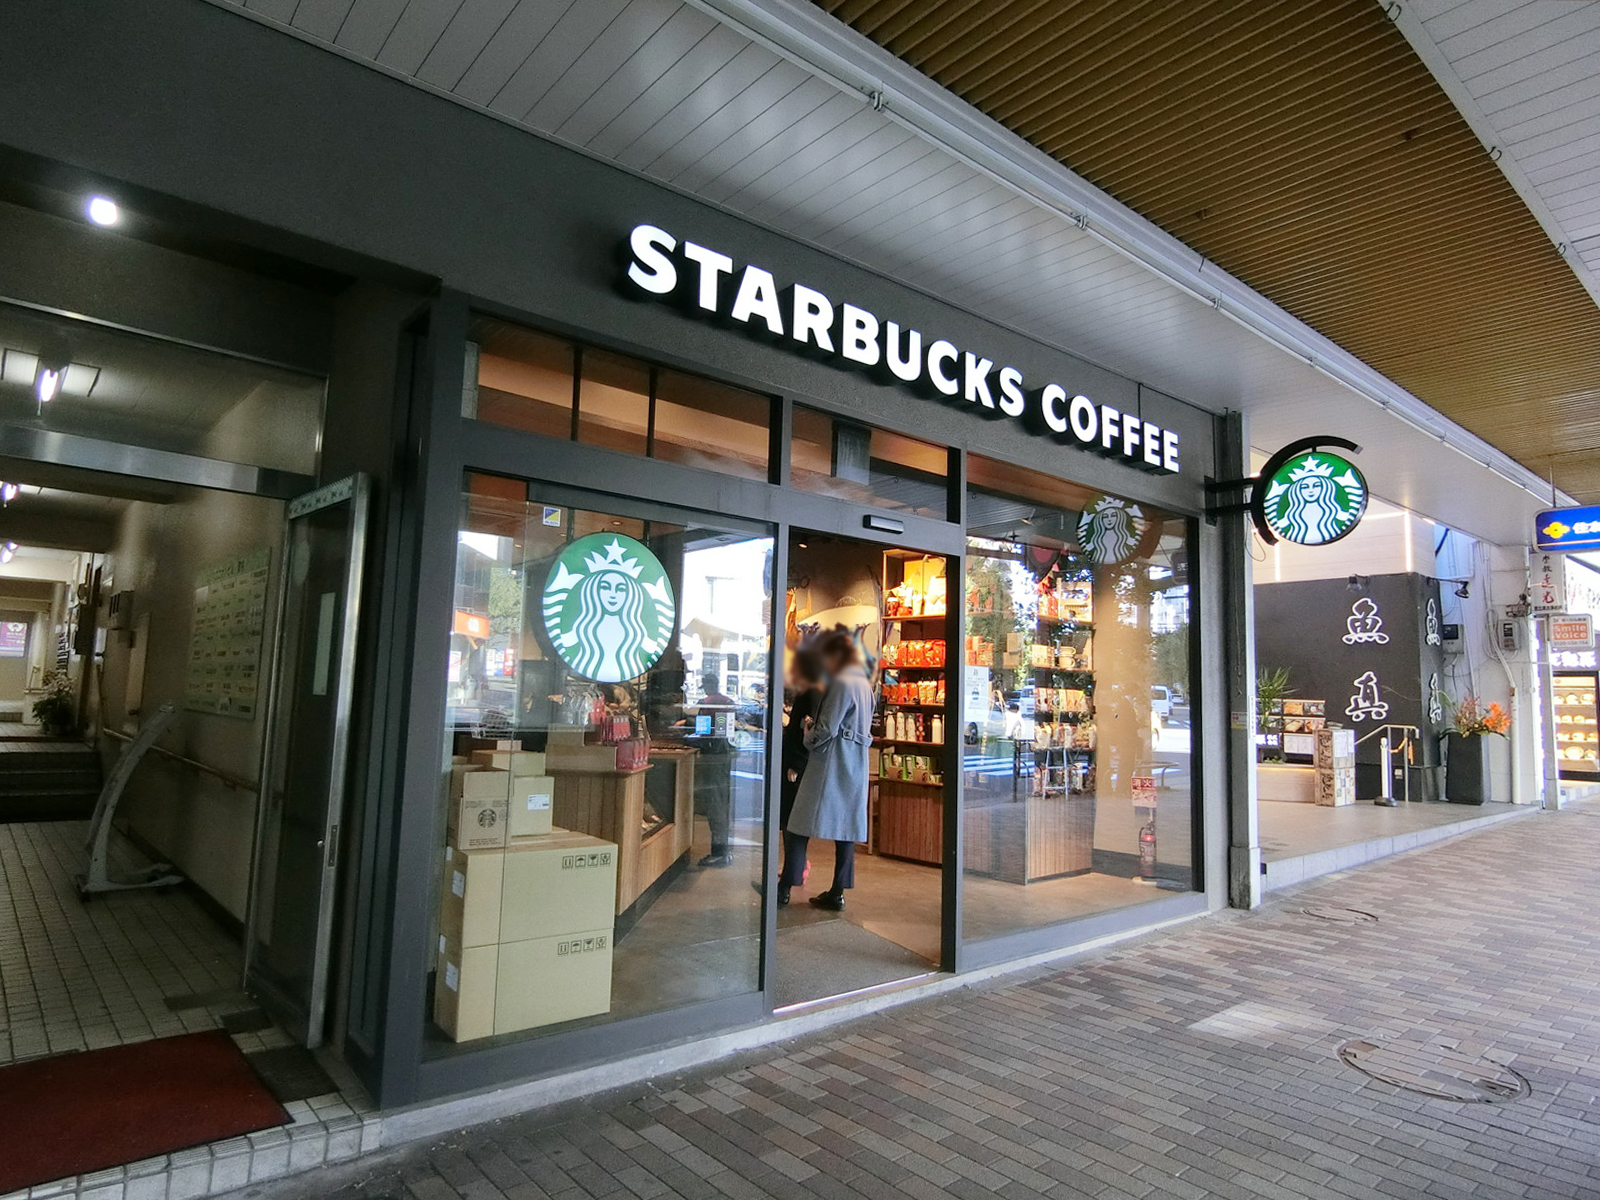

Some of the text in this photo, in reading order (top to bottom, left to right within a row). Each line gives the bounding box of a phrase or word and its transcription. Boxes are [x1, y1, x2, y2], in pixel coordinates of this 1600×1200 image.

[628, 225, 1180, 473] STARBUCKS COFFEE
[1554, 624, 1587, 632] Smile
[1554, 631, 1587, 639] Voice
